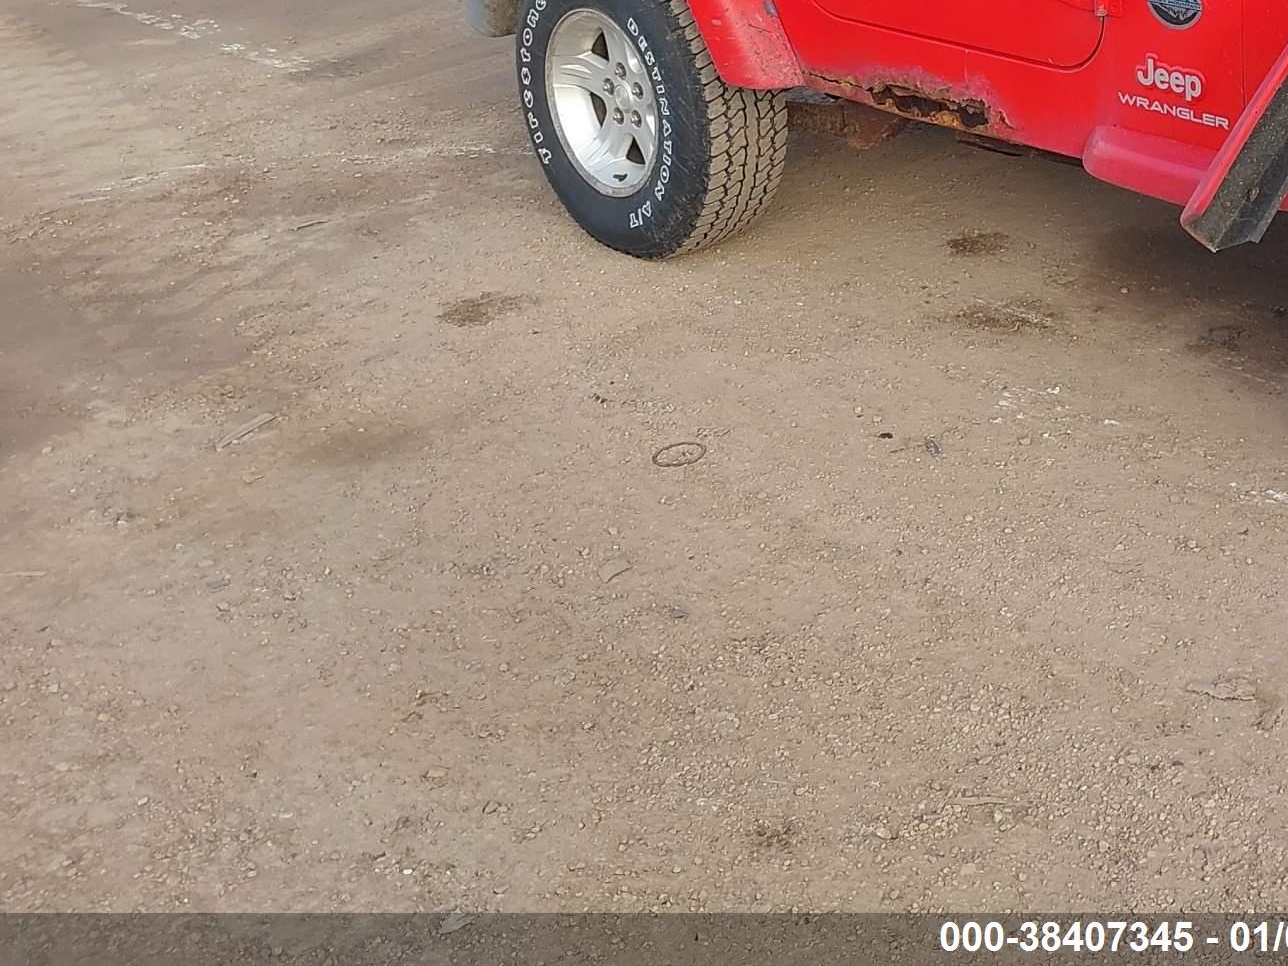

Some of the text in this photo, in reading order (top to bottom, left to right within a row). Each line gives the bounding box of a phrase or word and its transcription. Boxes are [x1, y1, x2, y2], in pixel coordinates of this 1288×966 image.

[1137, 58, 1202, 102] Jeep
[626, 17, 673, 229] DESTINATION A/T
[1118, 91, 1230, 131] WRANGLER
